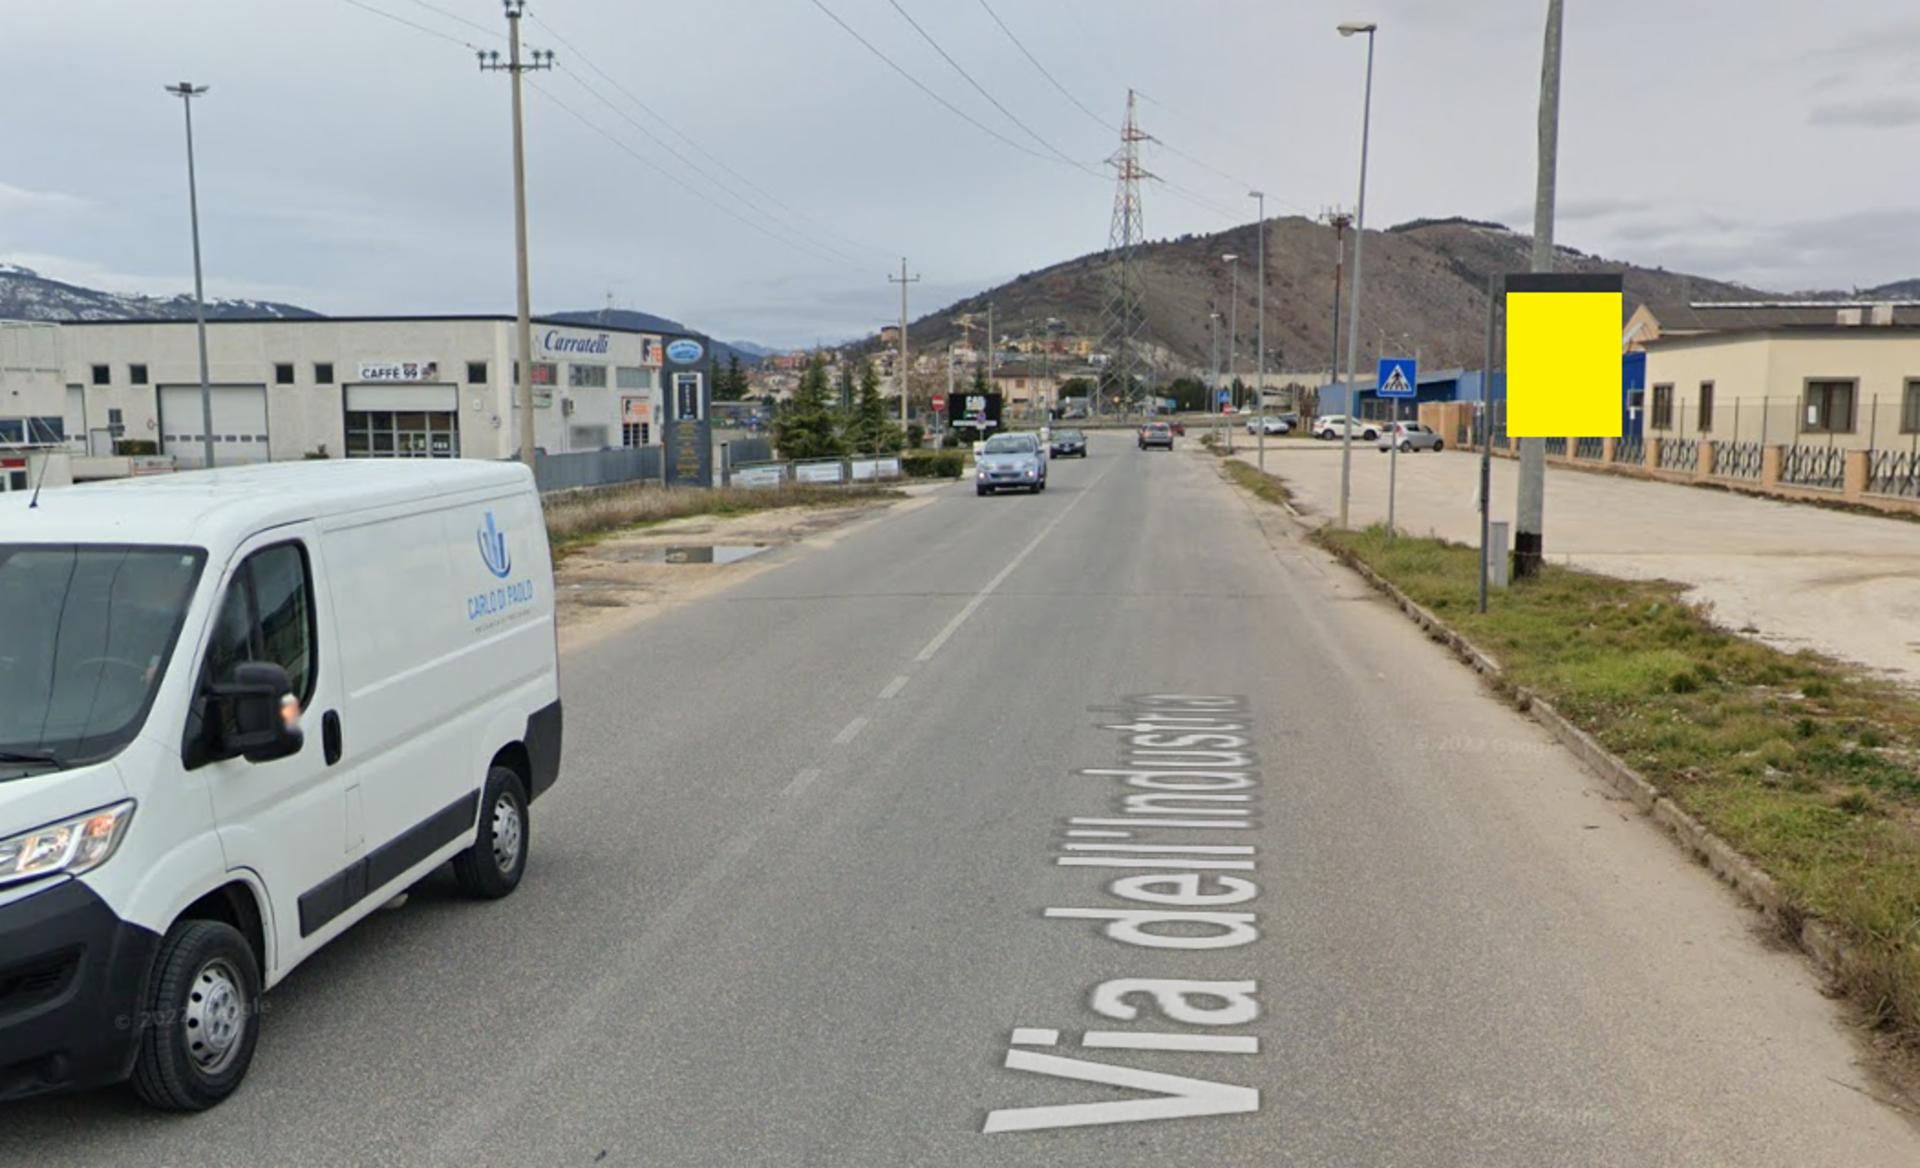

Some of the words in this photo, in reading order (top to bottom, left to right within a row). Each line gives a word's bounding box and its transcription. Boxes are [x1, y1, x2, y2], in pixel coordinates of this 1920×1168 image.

[544, 330, 609, 353] Carratelli
[403, 368, 417, 378] 99
[468, 591, 497, 619] CARLO
[497, 588, 507, 609] DI
[507, 579, 533, 604] PAOLO
